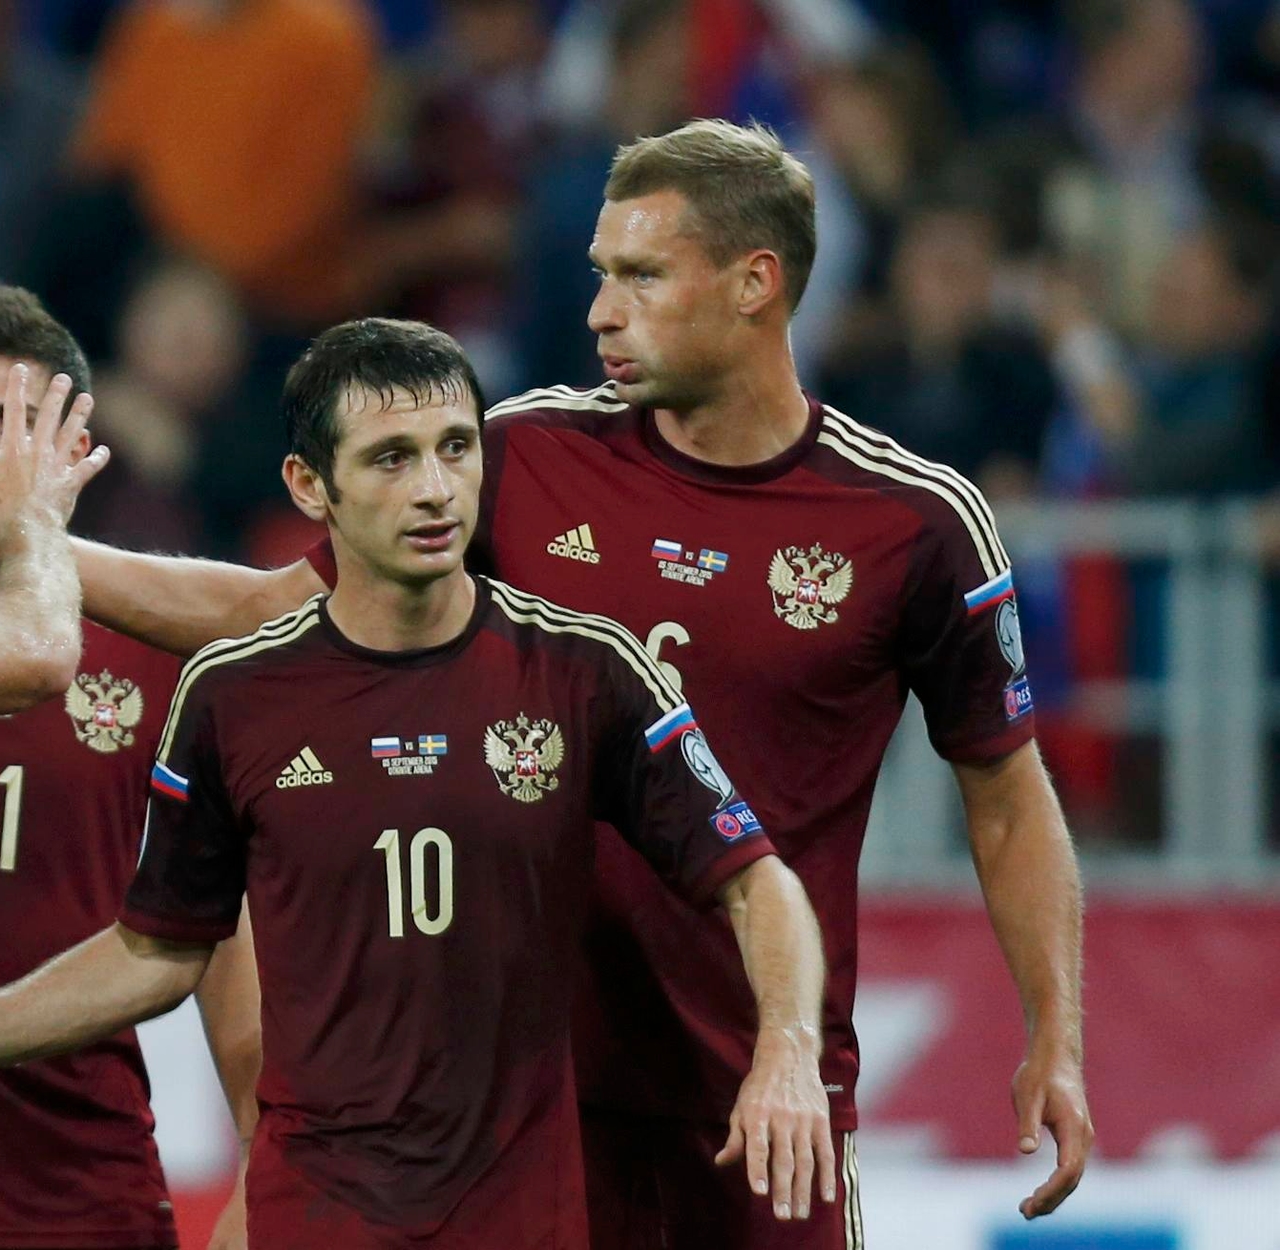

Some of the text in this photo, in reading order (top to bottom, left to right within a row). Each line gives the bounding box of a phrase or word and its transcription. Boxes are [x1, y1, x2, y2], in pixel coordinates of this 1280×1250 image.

[547, 541, 601, 564] adidas
[276, 770, 334, 789] adidas
[373, 827, 454, 938] 10
